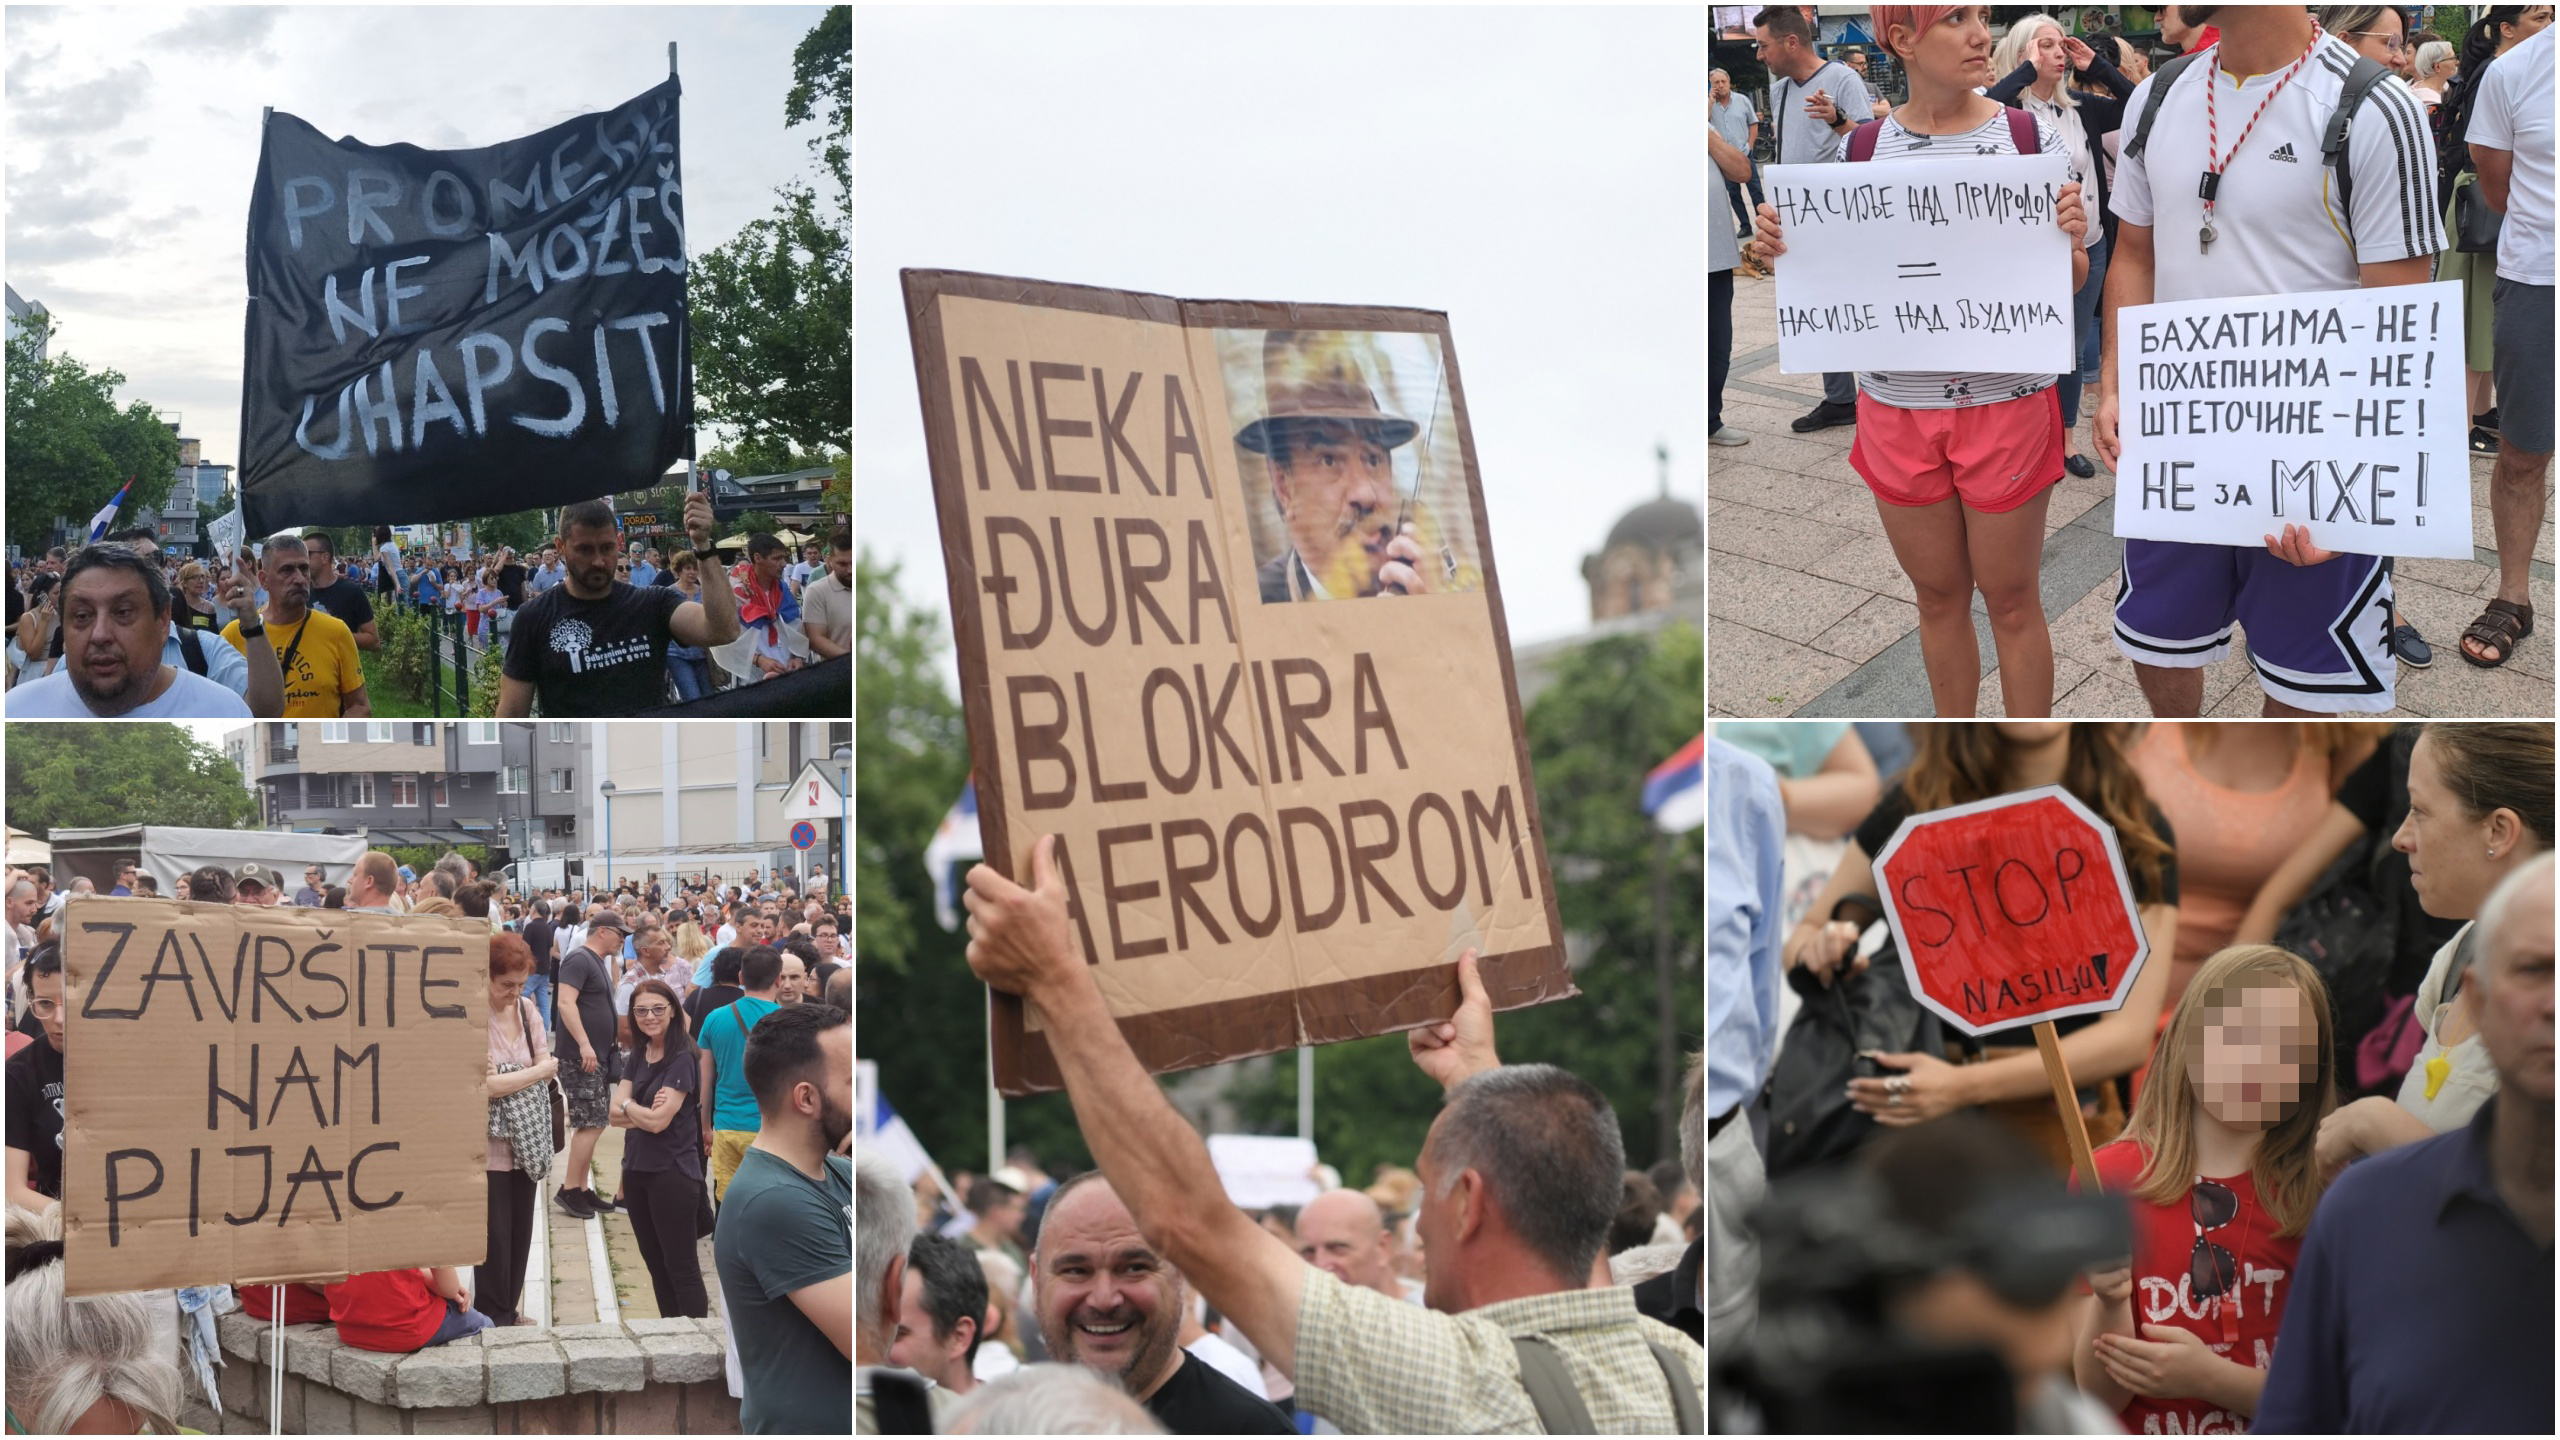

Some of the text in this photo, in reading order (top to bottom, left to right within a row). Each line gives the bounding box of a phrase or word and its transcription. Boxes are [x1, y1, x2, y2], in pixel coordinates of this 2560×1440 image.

[2268, 152, 2298, 164] adidas
[1774, 183, 1895, 227] НАСИЉЕ
[1907, 184, 1949, 226] НАД
[324, 159, 686, 345] NE MOŽEŠ
[1778, 298, 2064, 337] НАСИЉЕ НАД ЉУДИМА
[2139, 357, 2330, 391] ПОХЛЕПНИМА
[958, 355, 1214, 500] NEKA
[2140, 400, 2325, 437] ШТЕТОЧИНЕ
[2142, 461, 2196, 511] НЕ
[980, 515, 1238, 651] ĐURA
[584, 642, 650, 663] Odbranimo šume
[585, 650, 651, 671] Fruške gore
[1006, 652, 1410, 811] BLOKIRA
[1902, 847, 2084, 948] STOP
[81, 922, 468, 1028] ZAVRŠITE
[207, 1042, 381, 1131] NAM
[104, 1141, 404, 1248] PIJAC
